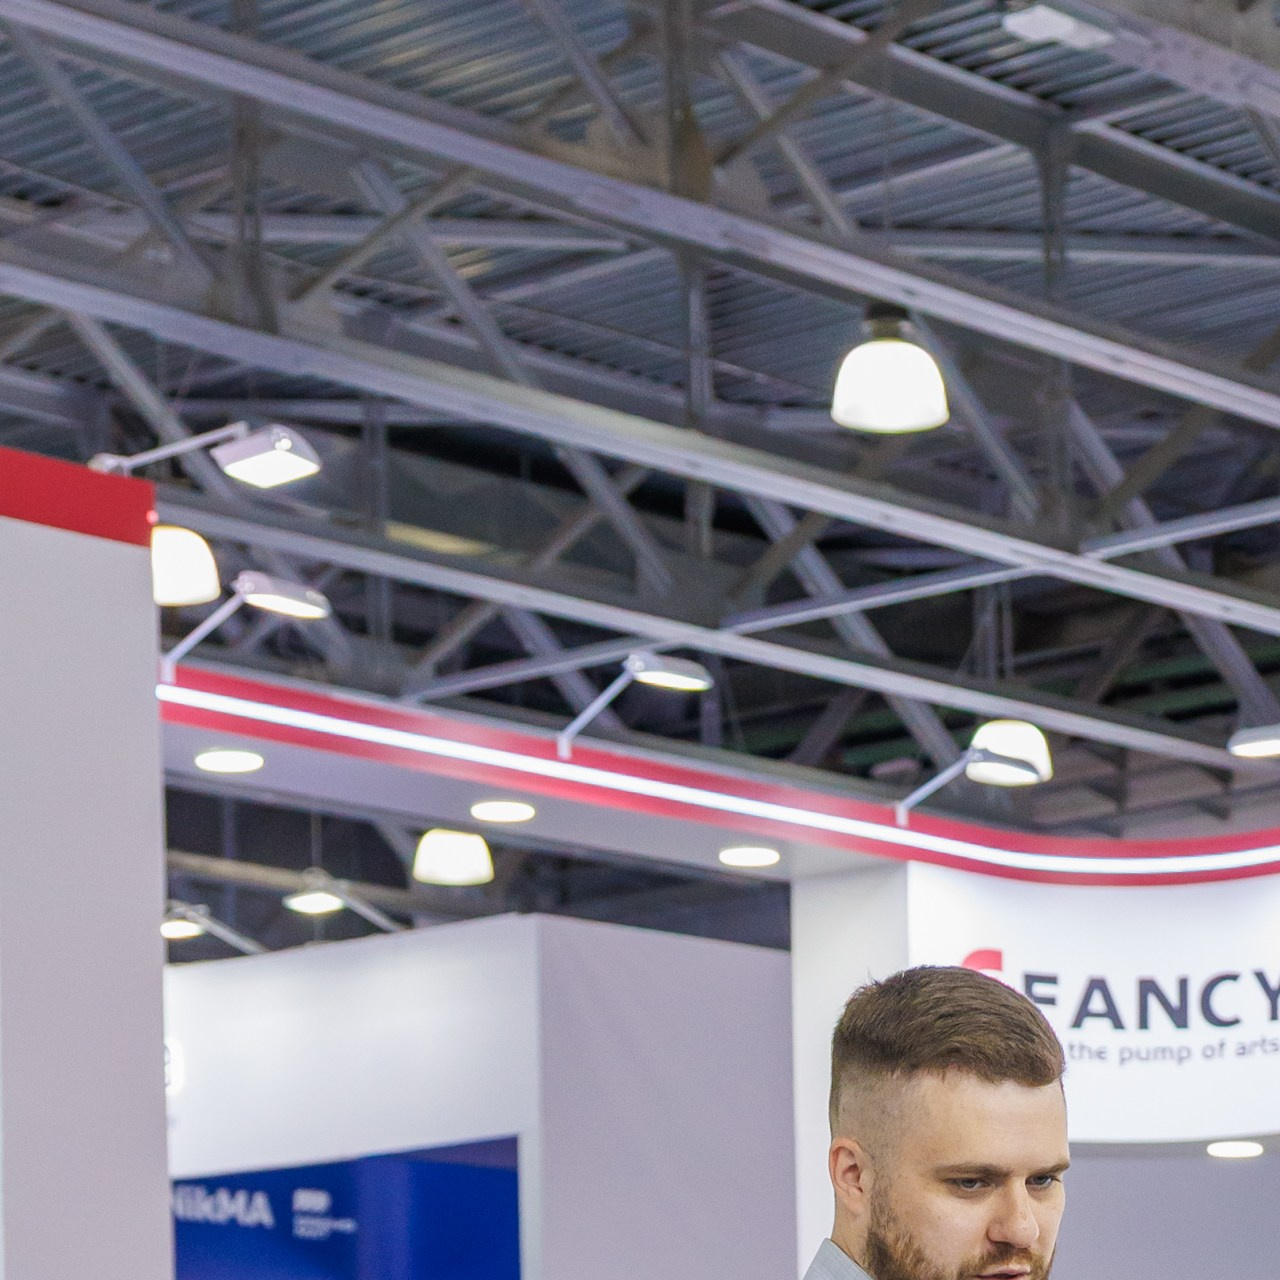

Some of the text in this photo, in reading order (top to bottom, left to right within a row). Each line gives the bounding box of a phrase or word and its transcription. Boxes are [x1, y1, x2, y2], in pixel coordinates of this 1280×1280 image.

[1068, 1036, 1280, 1066] the pump of arts
